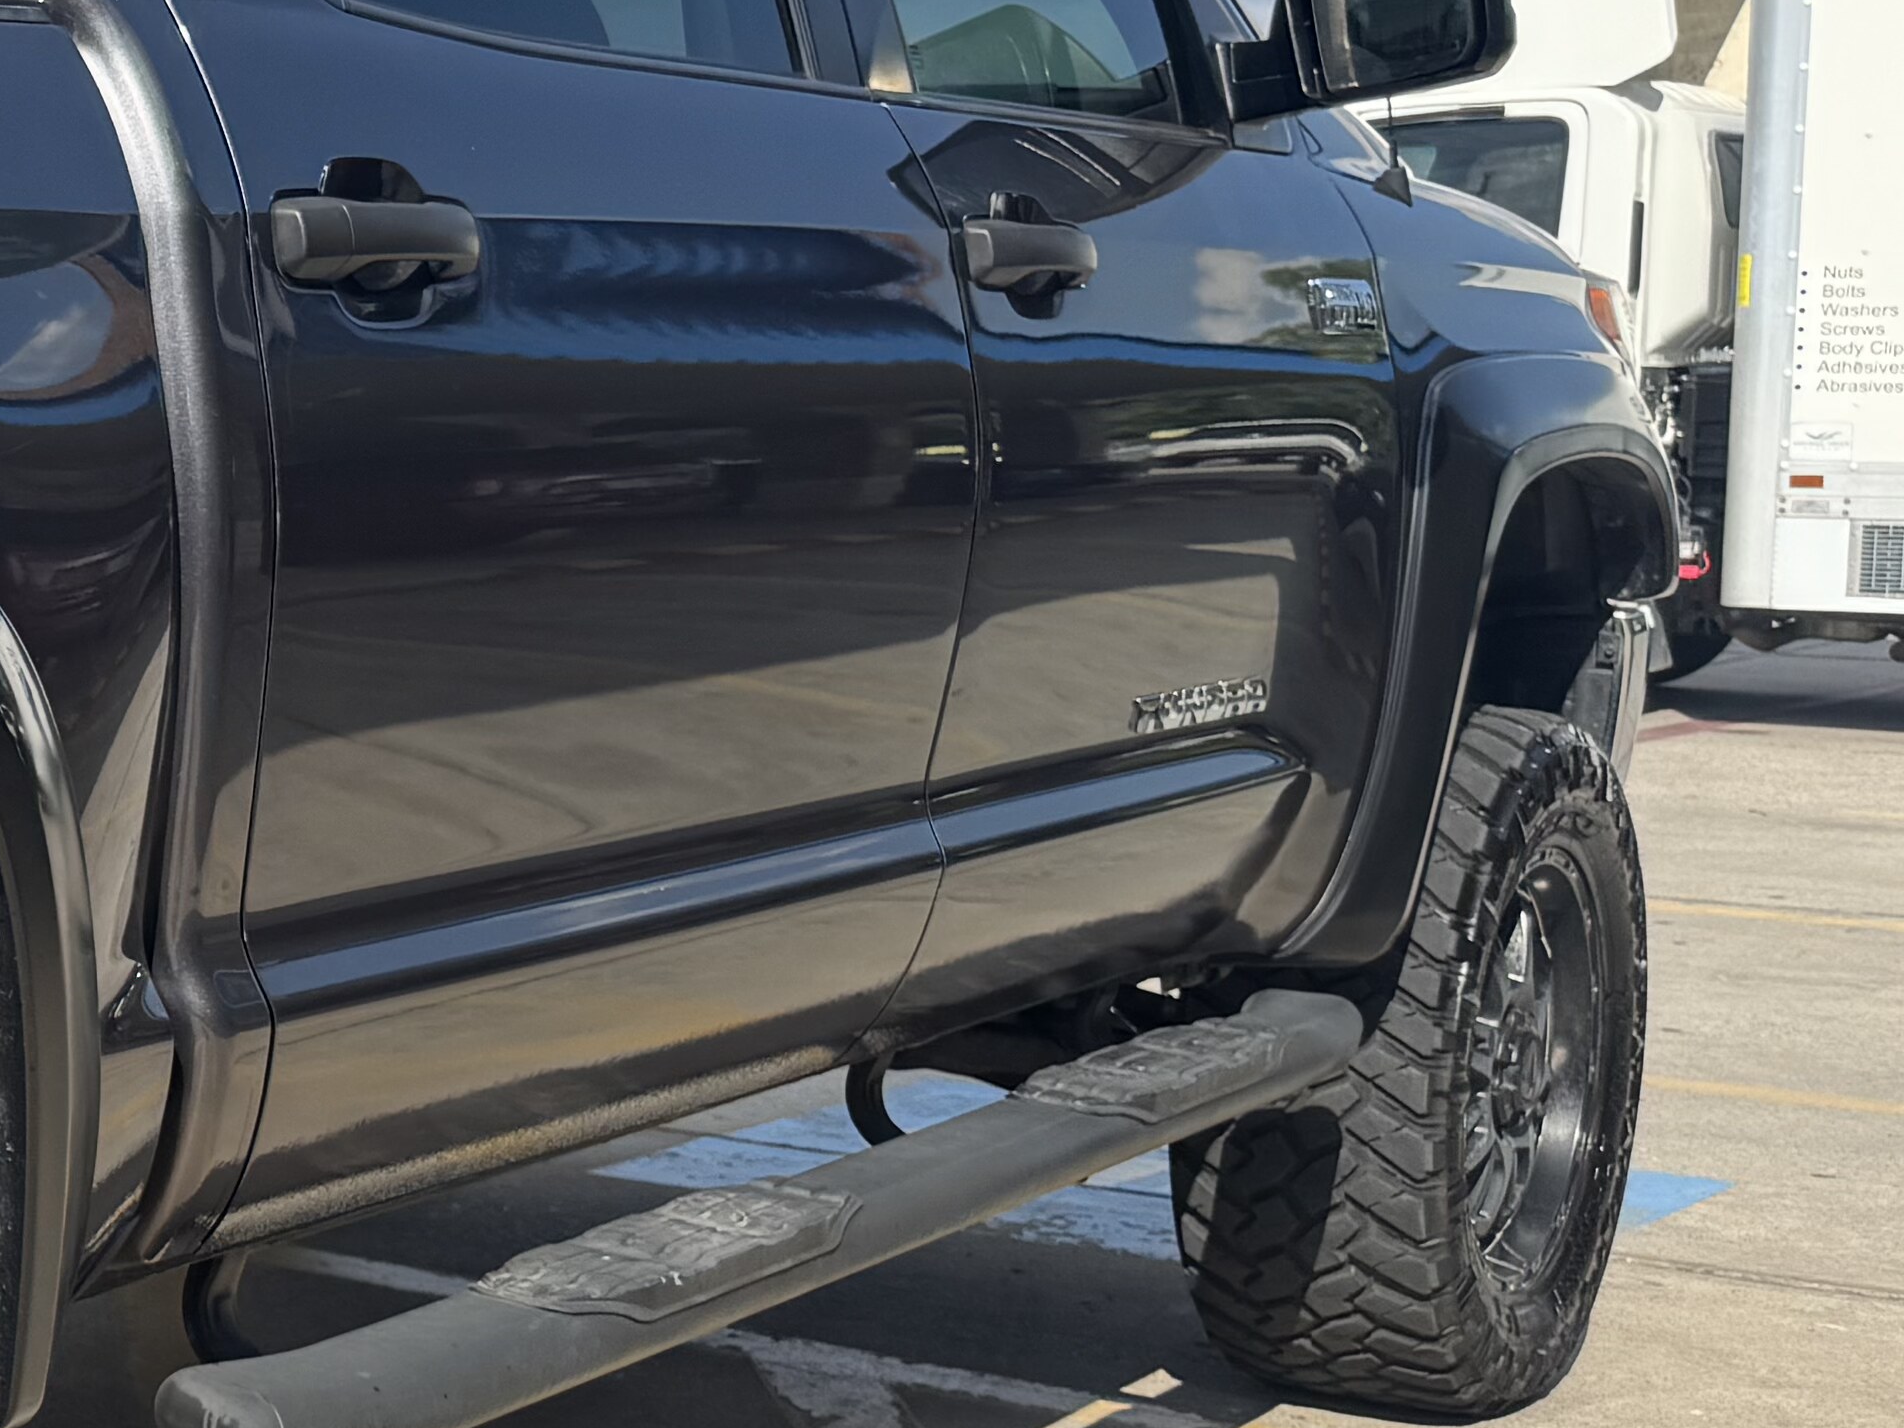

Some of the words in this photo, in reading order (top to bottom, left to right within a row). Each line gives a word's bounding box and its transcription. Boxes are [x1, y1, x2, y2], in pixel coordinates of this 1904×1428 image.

[1823, 265, 1864, 279] Nuts
[1822, 284, 1866, 298] Bolts
[1821, 303, 1899, 317] Washers
[1820, 321, 1885, 336] Screws
[1819, 340, 1864, 357] Body
